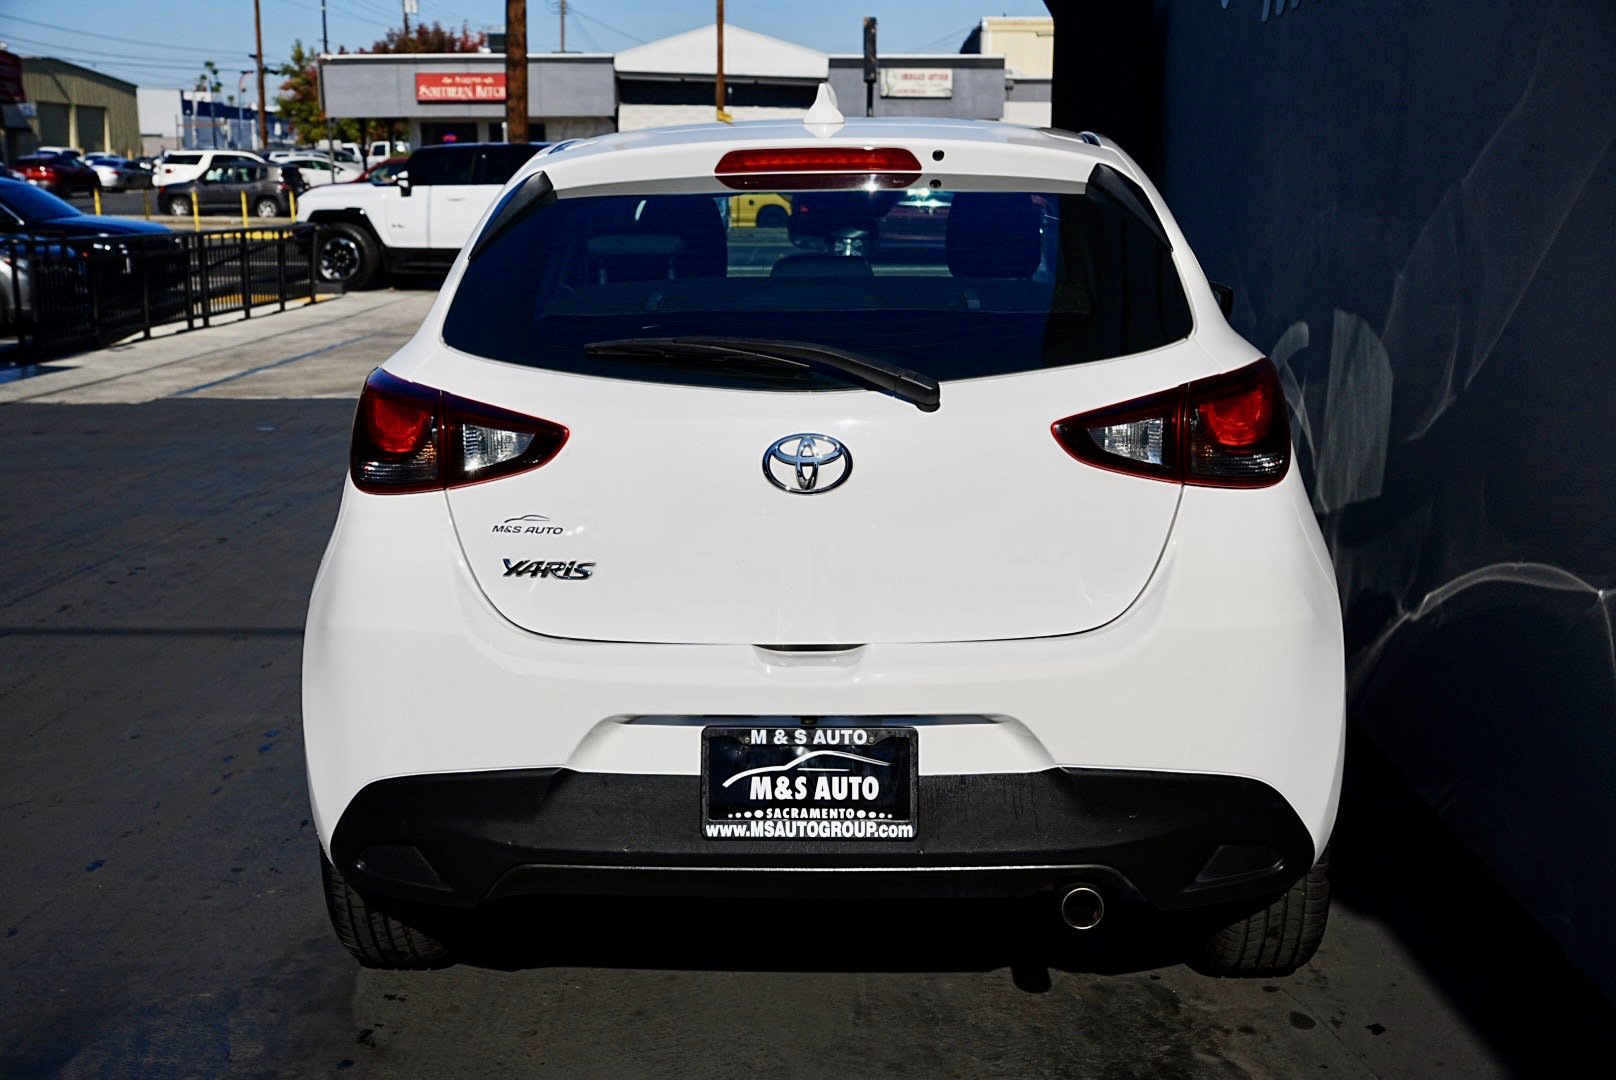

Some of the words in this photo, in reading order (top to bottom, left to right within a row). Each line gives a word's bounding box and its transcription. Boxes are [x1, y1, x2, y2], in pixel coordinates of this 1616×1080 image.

[491, 525, 522, 534] M&S
[524, 526, 563, 535] AUTO
[502, 558, 596, 580] YARIS
[750, 729, 767, 745] M
[773, 729, 788, 745] &
[794, 729, 807, 745] S
[813, 729, 868, 745] AUTO
[750, 776, 807, 800] M&S
[814, 776, 879, 800] AUTO
[766, 808, 855, 819] SACRAMENTO
[705, 821, 913, 838] www.MSAUTOGROUP.com
